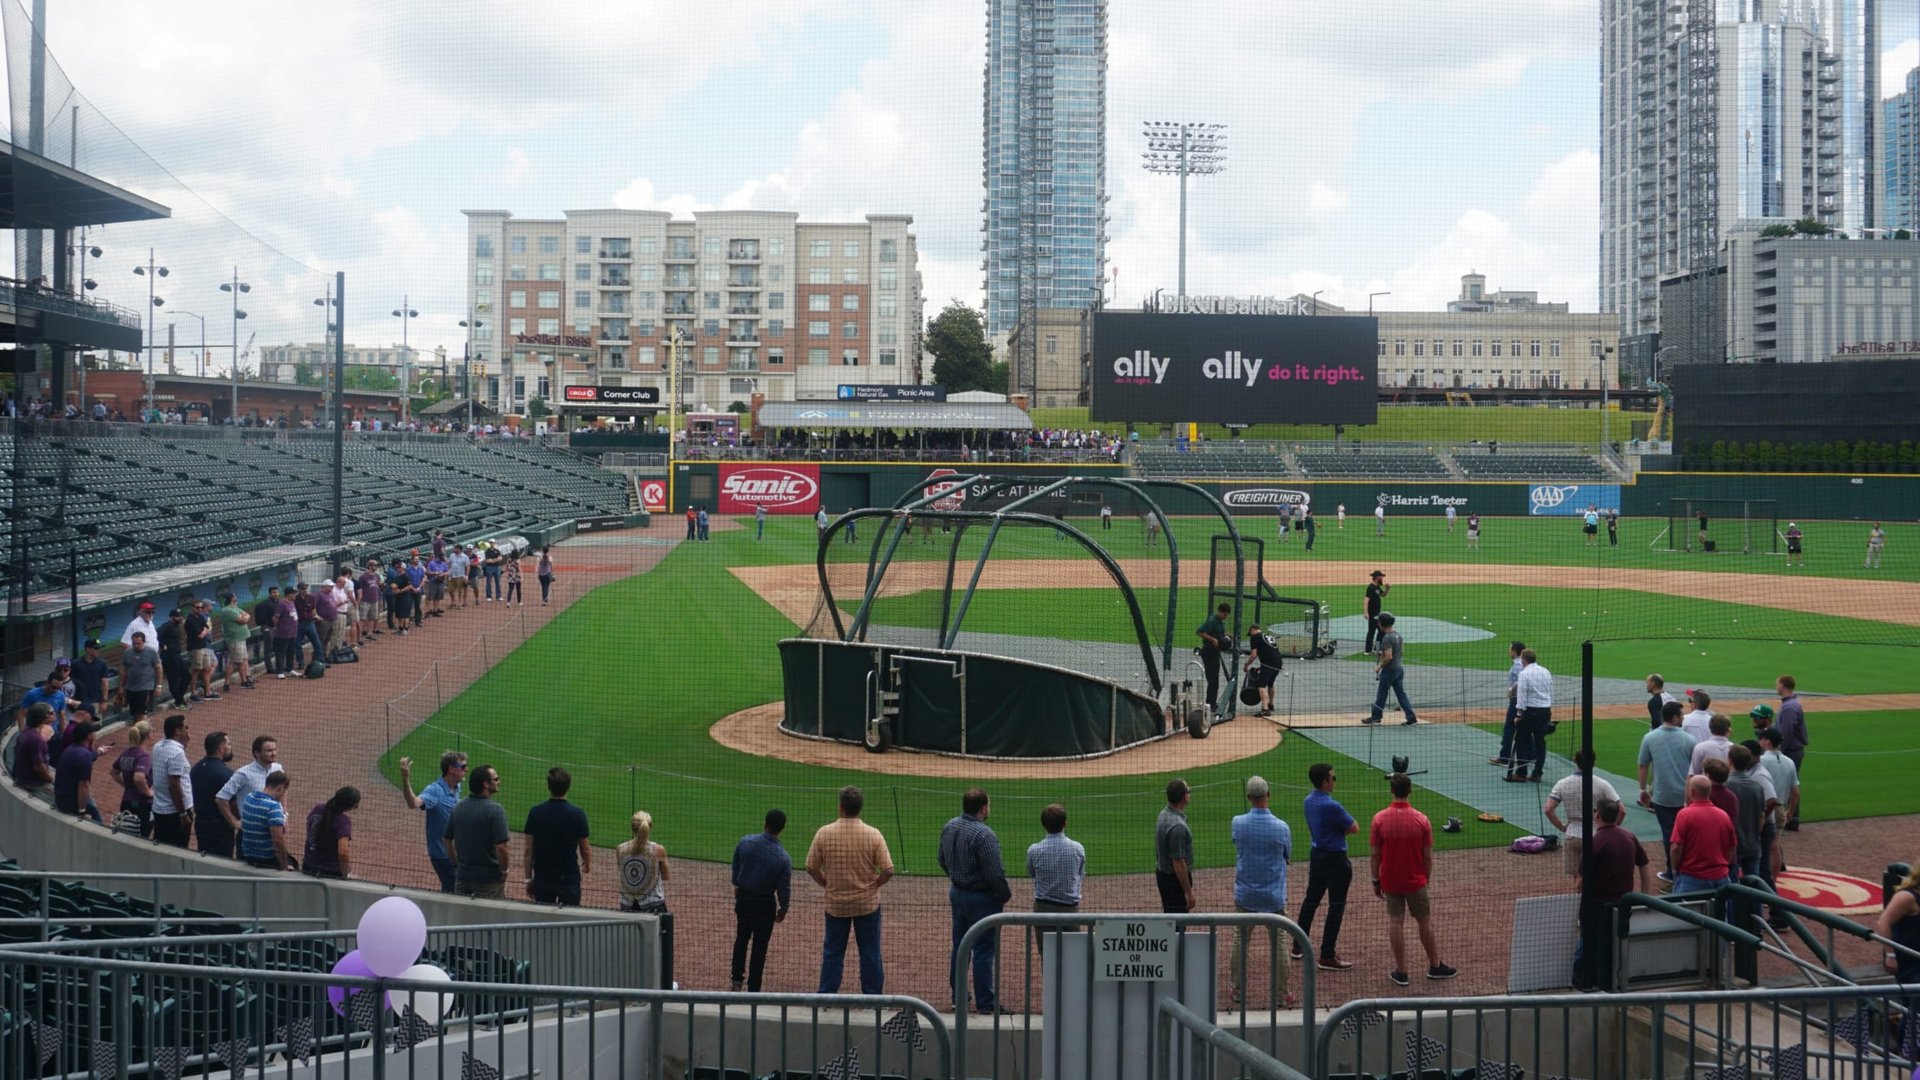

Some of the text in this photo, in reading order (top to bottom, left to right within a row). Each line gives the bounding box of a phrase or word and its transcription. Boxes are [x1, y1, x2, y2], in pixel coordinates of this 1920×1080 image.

[1224, 295, 1308, 316] BallPark
[1113, 350, 1171, 384] ally
[1202, 350, 1365, 387] ally do it right.
[603, 390, 651, 399] Corner Club
[918, 389, 935, 397] Area
[721, 475, 805, 494] Sonic
[972, 484, 1005, 497] SAE
[1009, 485, 1024, 497] AT
[731, 493, 796, 501] Automotive
[1232, 493, 1302, 504] FREIGHTLINER
[1391, 494, 1468, 506] Harris Teeter
[1535, 487, 1560, 505] AAA
[1126, 923, 1146, 937] NO
[1102, 938, 1168, 952] STANDING
[1129, 954, 1142, 962] OR
[1106, 964, 1164, 978] LEANING
